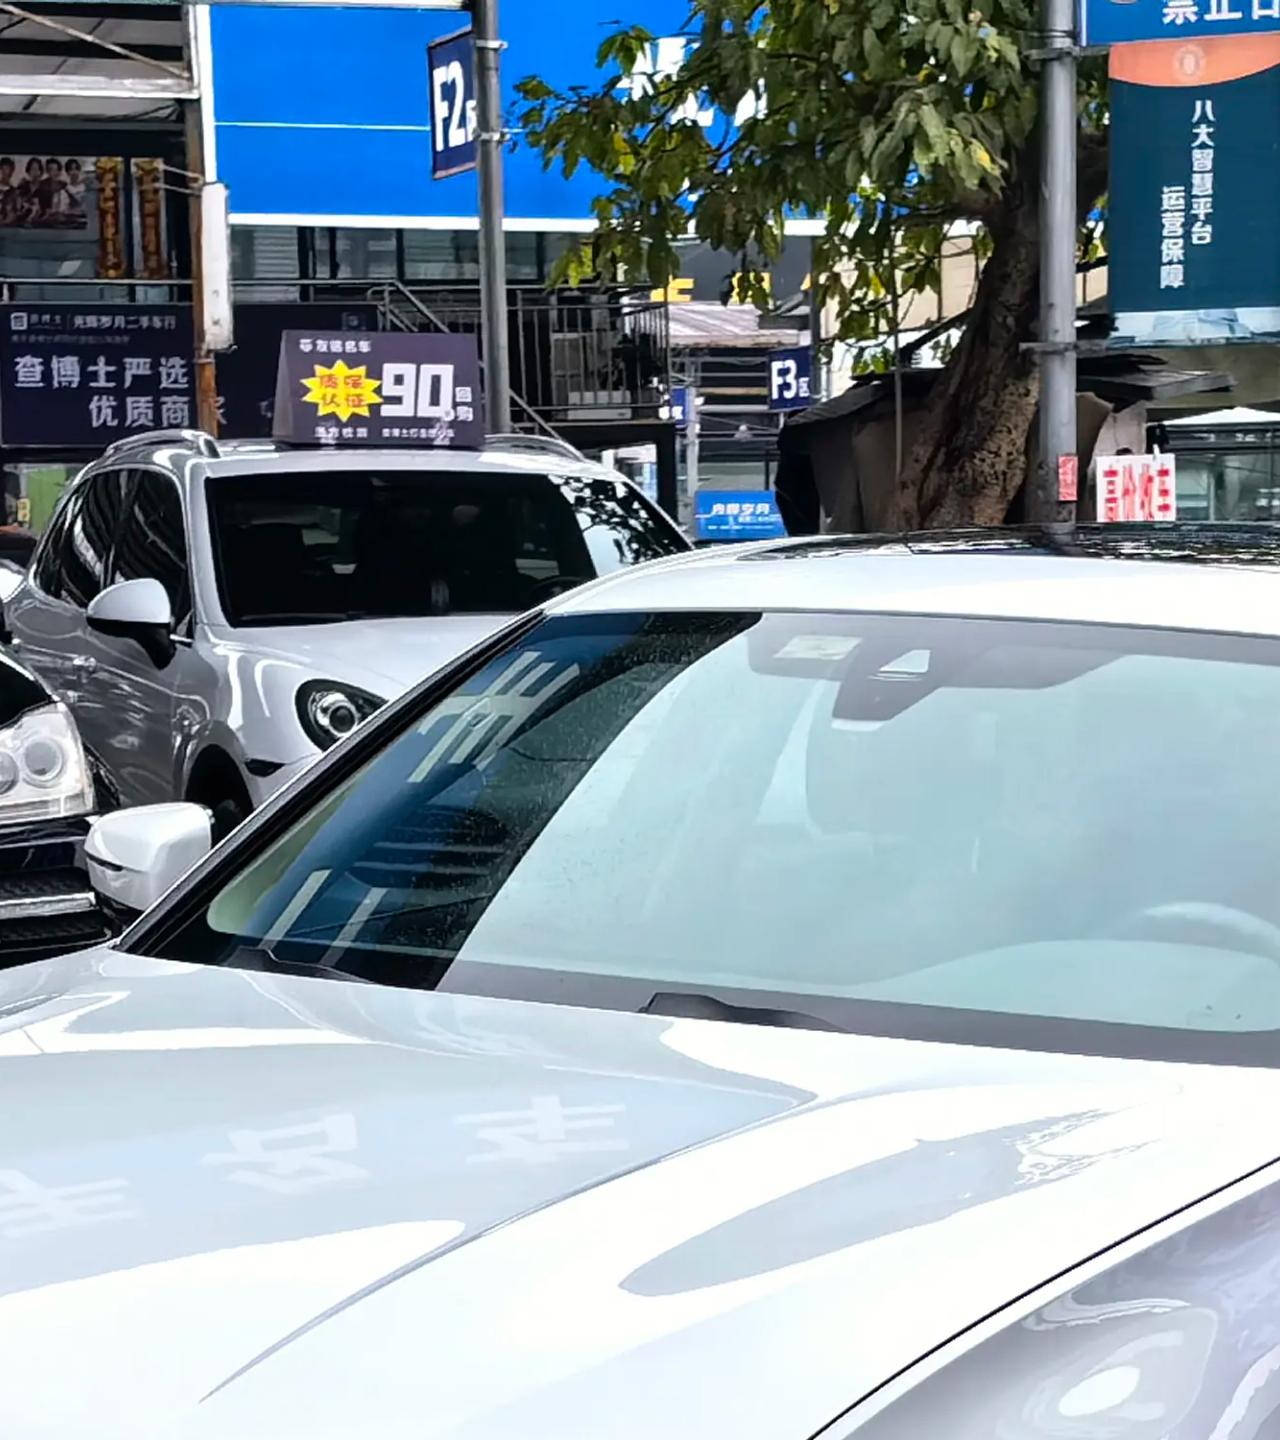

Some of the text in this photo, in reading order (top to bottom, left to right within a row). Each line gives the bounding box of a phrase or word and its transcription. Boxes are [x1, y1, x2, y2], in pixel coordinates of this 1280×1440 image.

[1191, 99, 1216, 246] 八大智慧平台
[1159, 184, 1186, 290] 运营保障
[14, 354, 190, 389] 查博士严选
[380, 363, 455, 418] 90
[771, 359, 810, 400] F3区
